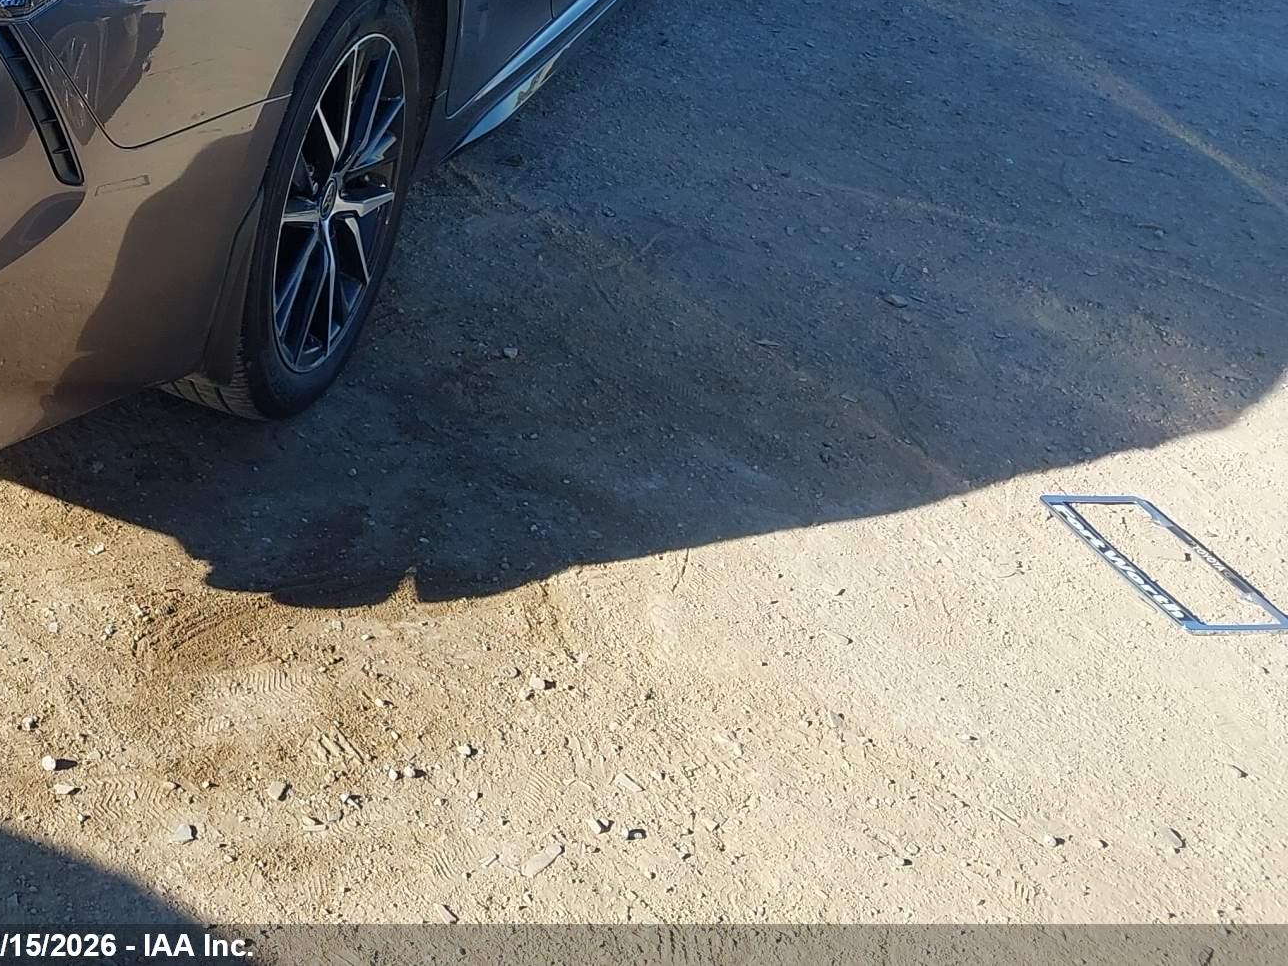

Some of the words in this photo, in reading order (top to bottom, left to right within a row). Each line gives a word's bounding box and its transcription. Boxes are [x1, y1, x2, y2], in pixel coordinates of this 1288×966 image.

[1052, 504, 1105, 548] Fort
[1103, 550, 1185, 618] Worth
[1192, 542, 1226, 572] TOYOTA
